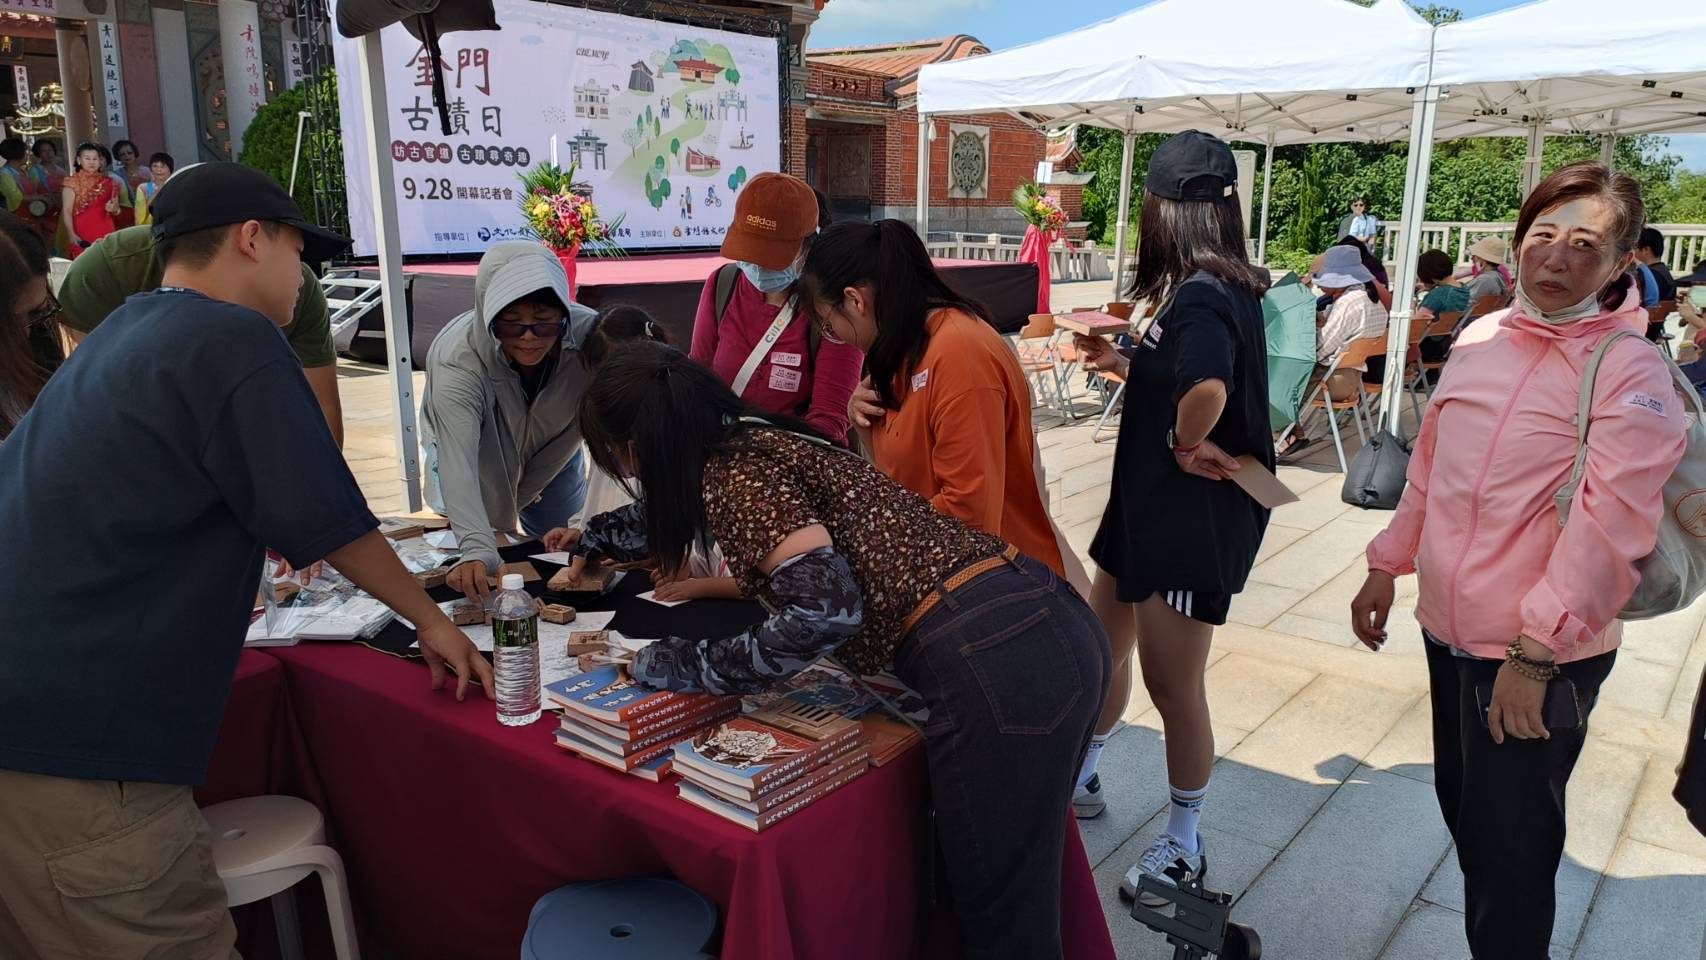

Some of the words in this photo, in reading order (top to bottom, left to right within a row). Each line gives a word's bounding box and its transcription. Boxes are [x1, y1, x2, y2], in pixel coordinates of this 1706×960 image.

[405, 42, 490, 96] 金門
[402, 177, 453, 200] 9.28
[456, 186, 513, 200] 開幕記者會
[746, 214, 777, 228] adidas
